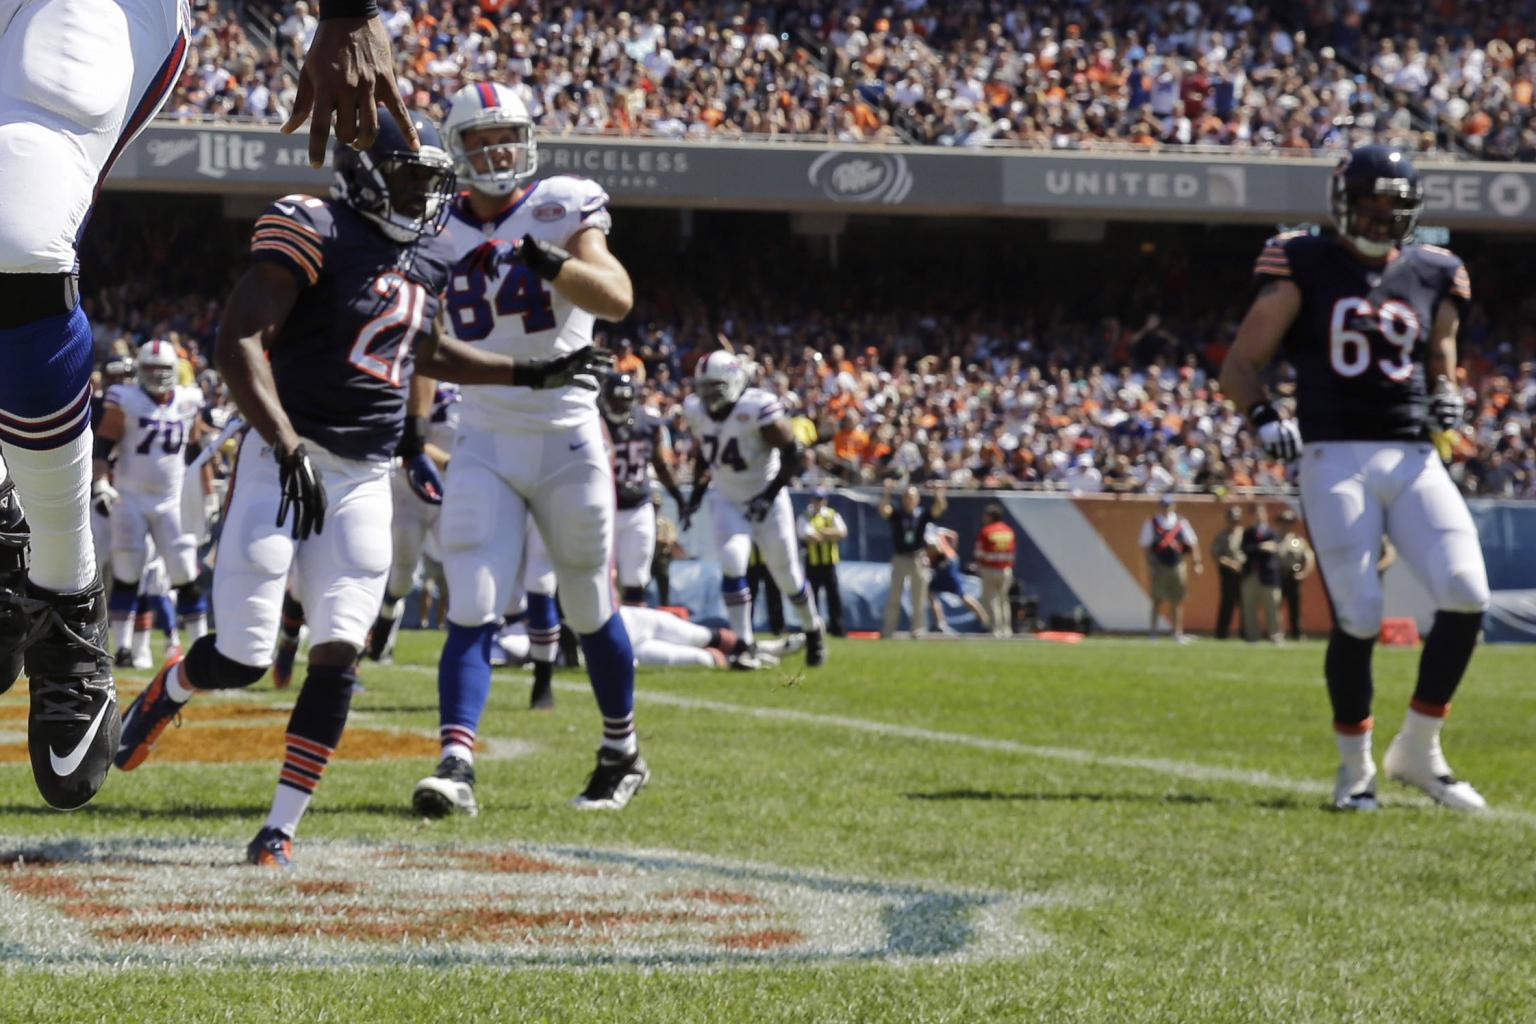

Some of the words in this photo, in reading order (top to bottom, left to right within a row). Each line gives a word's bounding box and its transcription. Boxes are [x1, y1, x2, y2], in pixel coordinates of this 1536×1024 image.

[197, 132, 266, 178] Lite
[538, 148, 688, 173] PRICELESS
[1046, 170, 1199, 198] UNITED
[447, 261, 557, 342] 84
[1330, 296, 1421, 382] 69
[137, 417, 183, 455] 70
